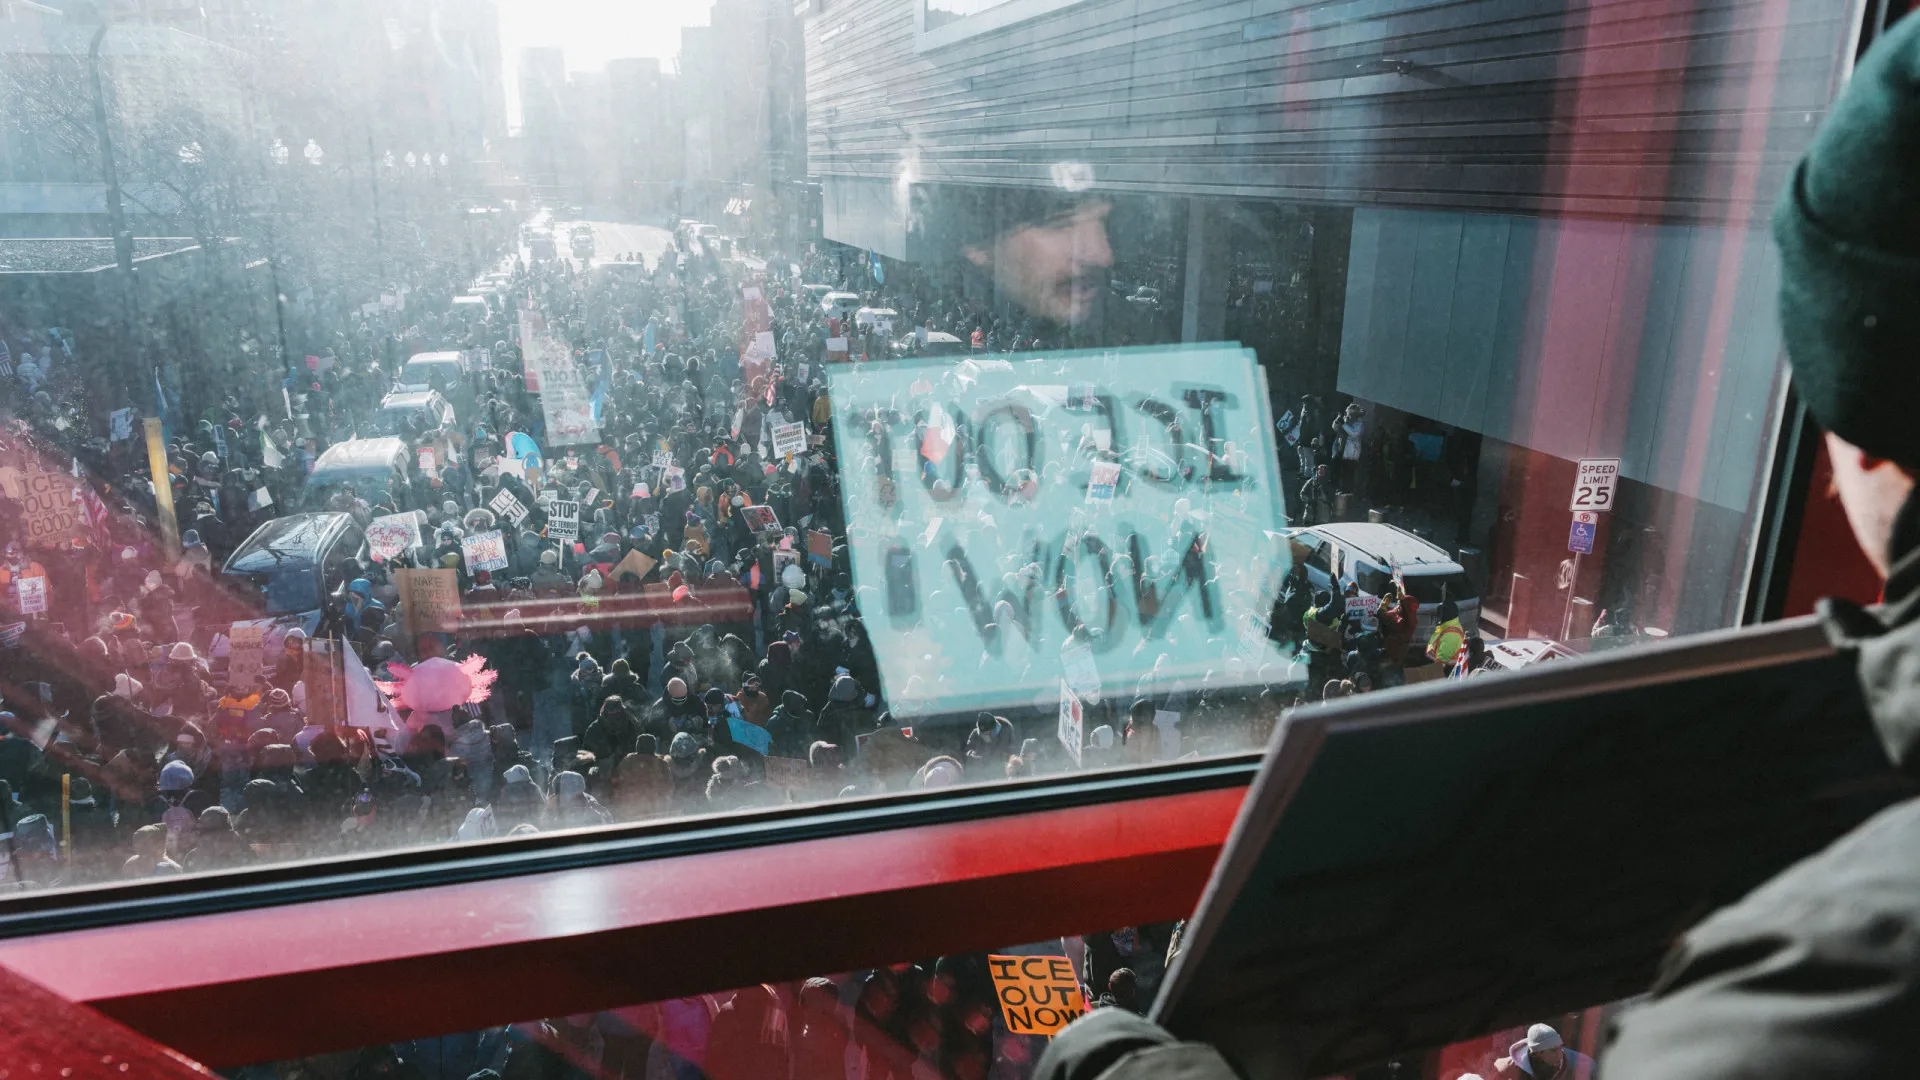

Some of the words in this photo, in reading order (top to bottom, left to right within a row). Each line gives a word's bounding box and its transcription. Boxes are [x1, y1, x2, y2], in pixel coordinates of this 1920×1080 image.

[775, 429, 802, 439] IMMIGRANT
[776, 436, 803, 446] NEIGHBORS
[1581, 465, 1616, 474] SPEED
[20, 474, 65, 496] ICE
[1583, 476, 1611, 484] LIMIT
[25, 491, 65, 513] OUT
[491, 492, 515, 514] ICE
[1575, 486, 1610, 505] 25
[507, 499, 526, 523] OUT
[549, 501, 578, 519] STOP
[31, 513, 73, 536] GOOD
[558, 521, 577, 529] TERROR
[413, 576, 444, 587] MAKE
[413, 588, 451, 600] ORWELL
[1348, 597, 1377, 607] ABOLISH
[1347, 609, 1365, 617] ICE
[990, 958, 1075, 981] ICE
[1001, 985, 1076, 1006] OUT
[1008, 1006, 1084, 1030] NOW
